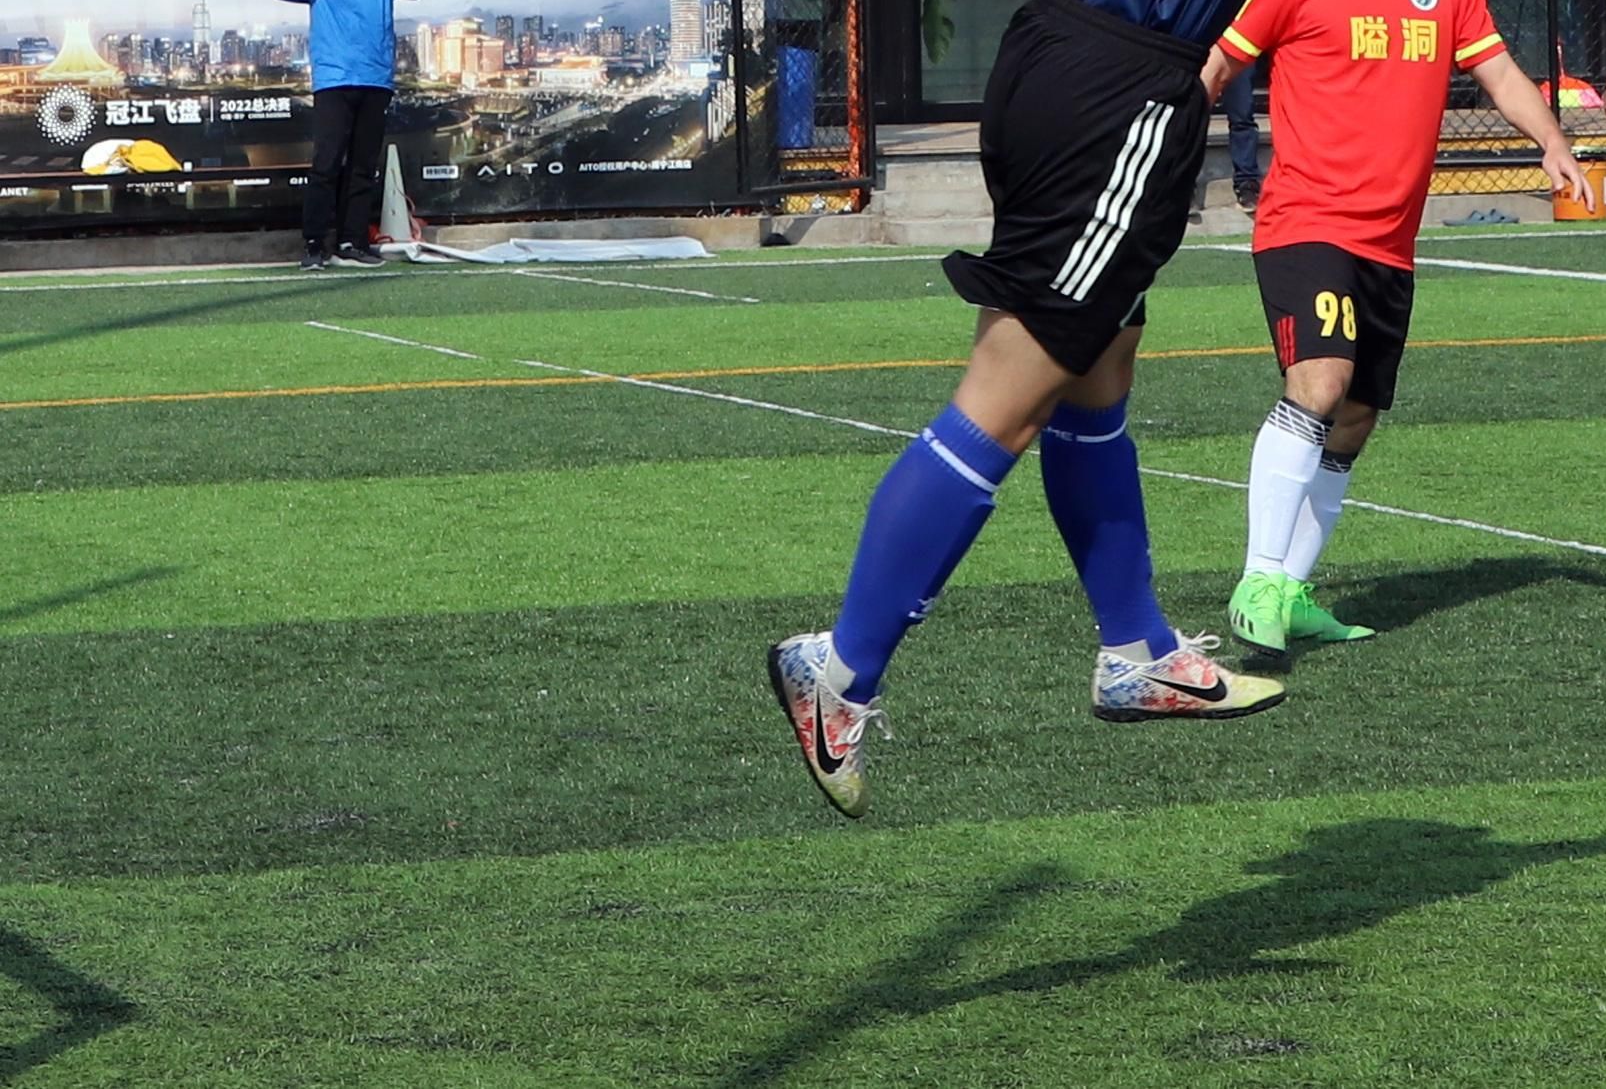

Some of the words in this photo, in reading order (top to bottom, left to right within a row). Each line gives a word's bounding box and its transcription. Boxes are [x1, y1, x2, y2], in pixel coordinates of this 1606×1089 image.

[104, 99, 202, 126] 冠江飞盘
[1314, 291, 1357, 341] 98
